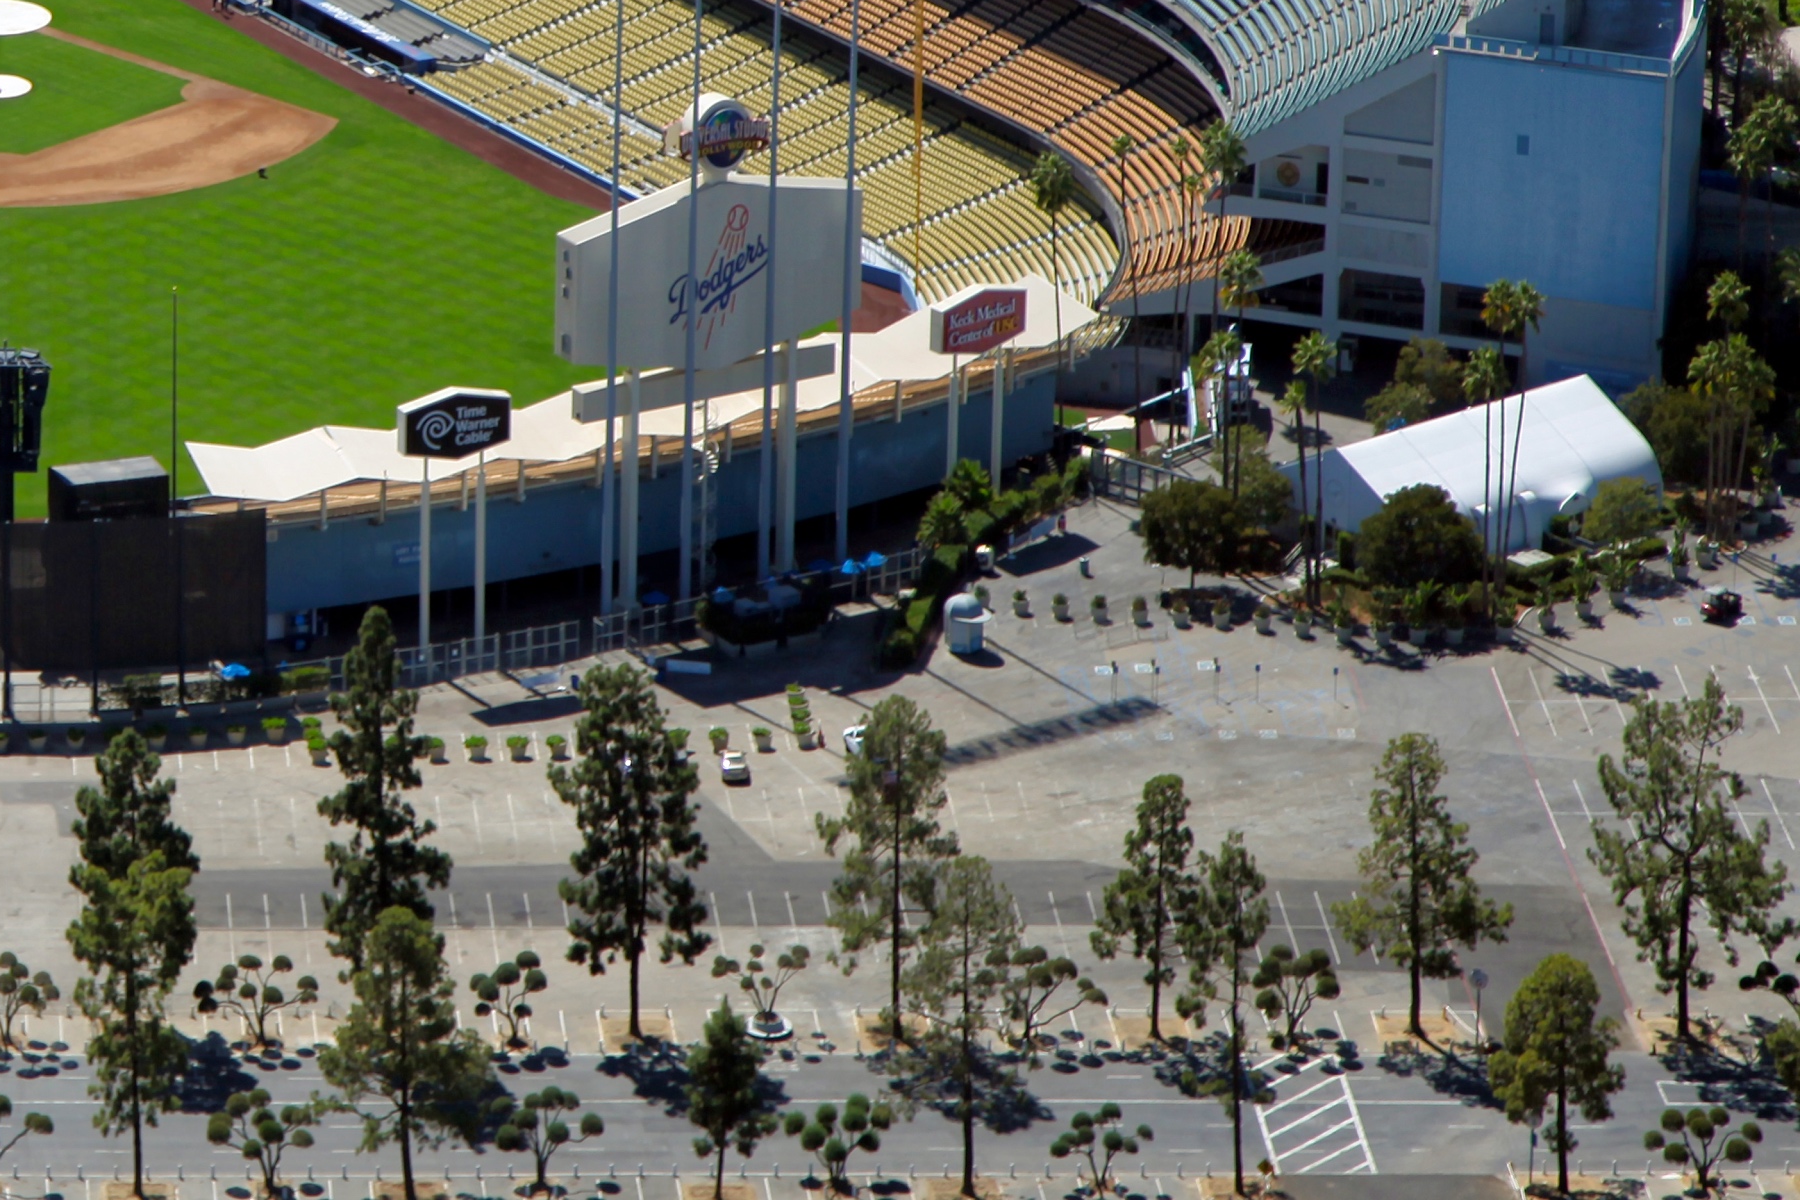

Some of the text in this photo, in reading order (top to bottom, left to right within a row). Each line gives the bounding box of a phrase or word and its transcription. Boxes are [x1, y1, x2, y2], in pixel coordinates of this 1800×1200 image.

[681, 122, 732, 153] UVERSAL
[668, 233, 769, 325] Dodgers
[949, 298, 1016, 330] Keck Medical
[949, 315, 1019, 347] Center of USC
[455, 405, 487, 419] Time
[455, 416, 501, 433] Warner
[454, 431, 492, 446] Cable
